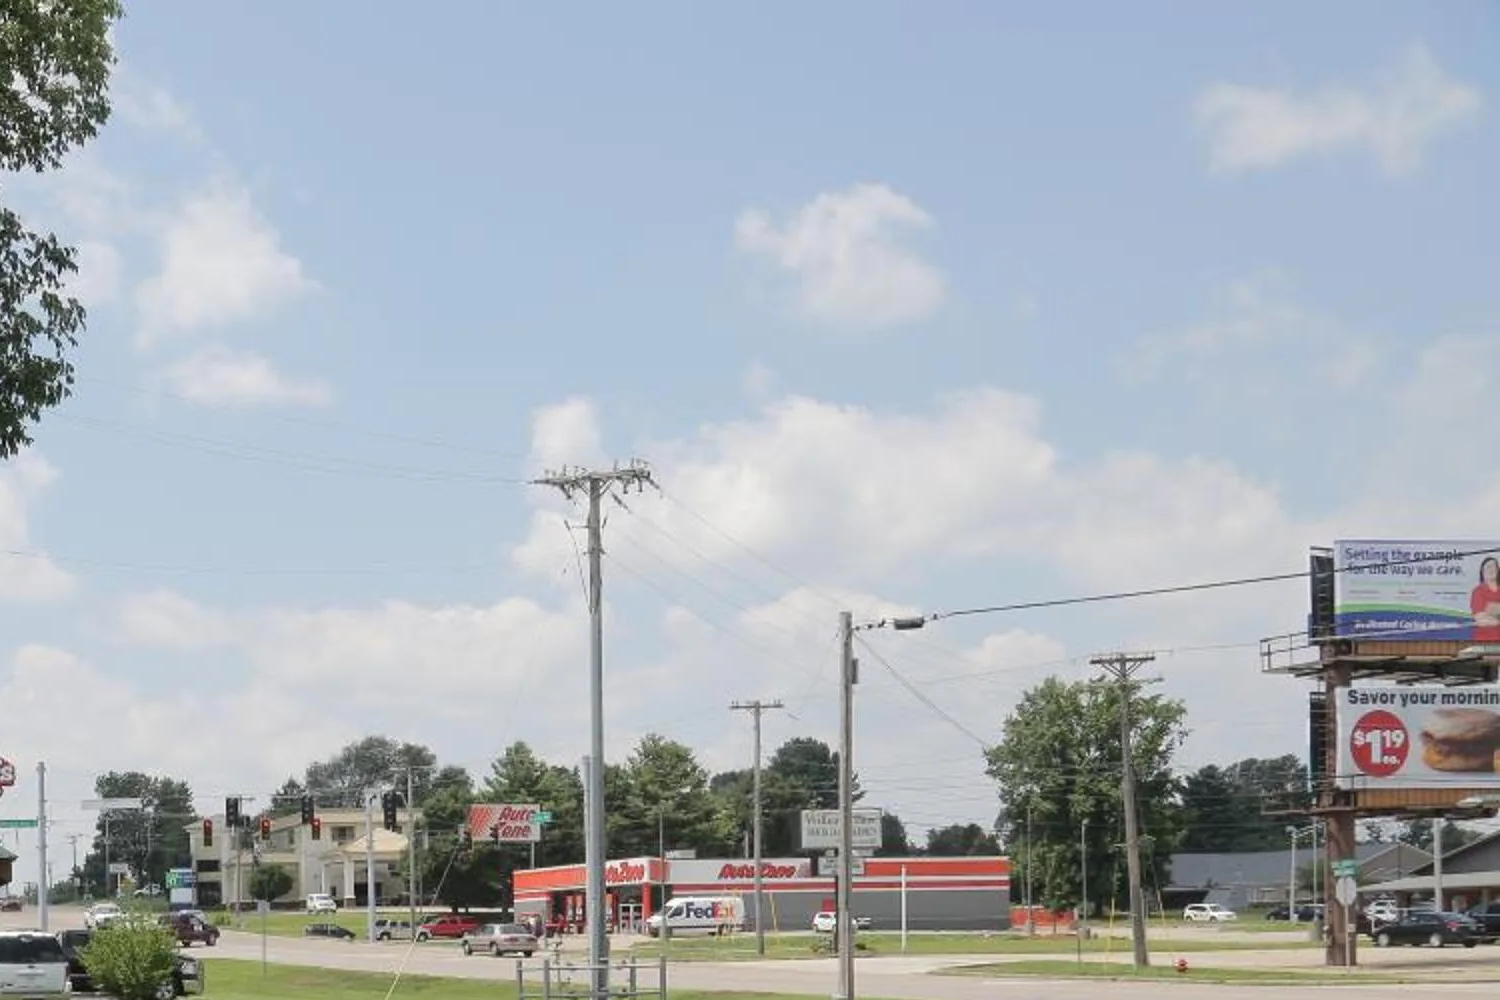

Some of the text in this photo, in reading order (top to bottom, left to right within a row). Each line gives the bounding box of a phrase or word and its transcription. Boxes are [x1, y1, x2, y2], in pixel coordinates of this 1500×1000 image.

[1345, 547, 1463, 563] Setting the example
[1368, 564, 1387, 575] the
[1391, 565, 1413, 576] way
[1416, 565, 1433, 575] we
[1348, 689, 1396, 705] Savor
[1400, 692, 1437, 707] your
[605, 862, 645, 882] utoZone
